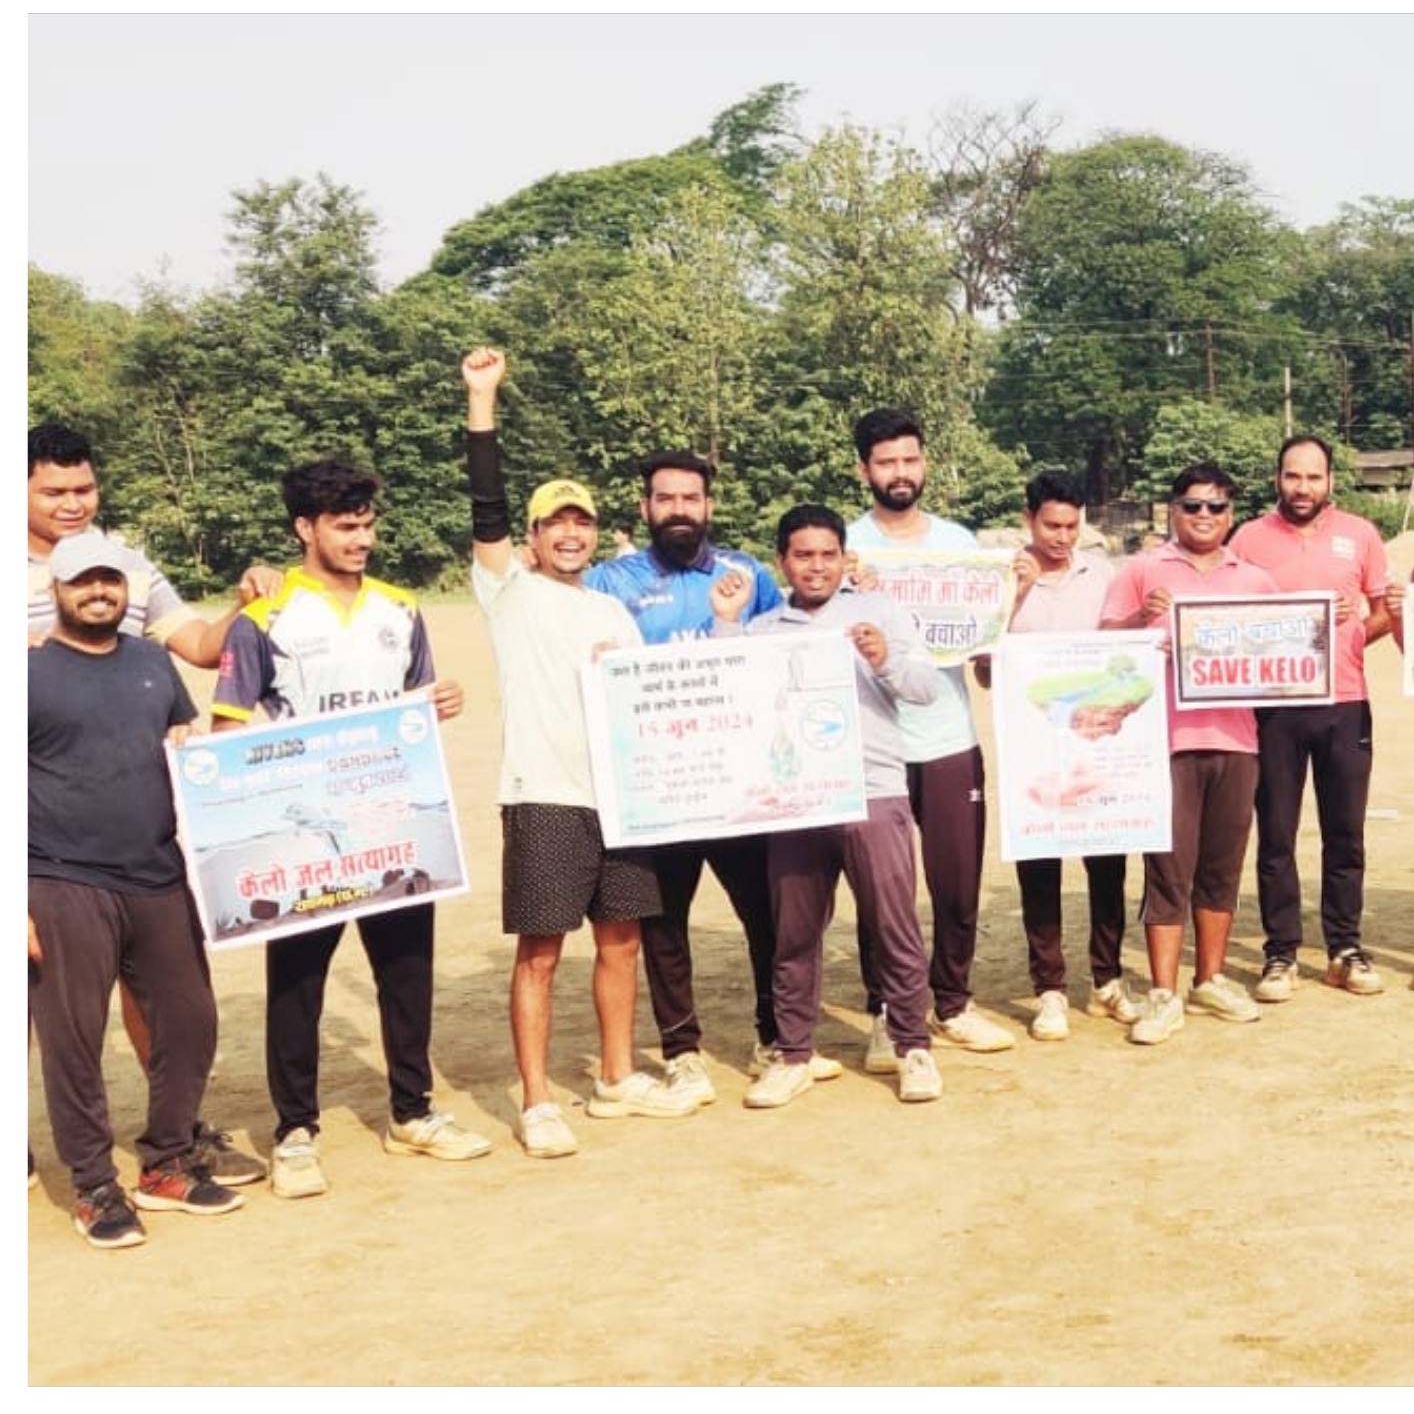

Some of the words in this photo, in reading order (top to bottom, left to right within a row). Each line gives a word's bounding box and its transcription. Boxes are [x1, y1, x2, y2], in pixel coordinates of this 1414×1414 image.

[1192, 657, 1251, 685] SAVE
[1259, 655, 1316, 683] KELO
[238, 860, 287, 900] केलो
[294, 859, 333, 889] जल
